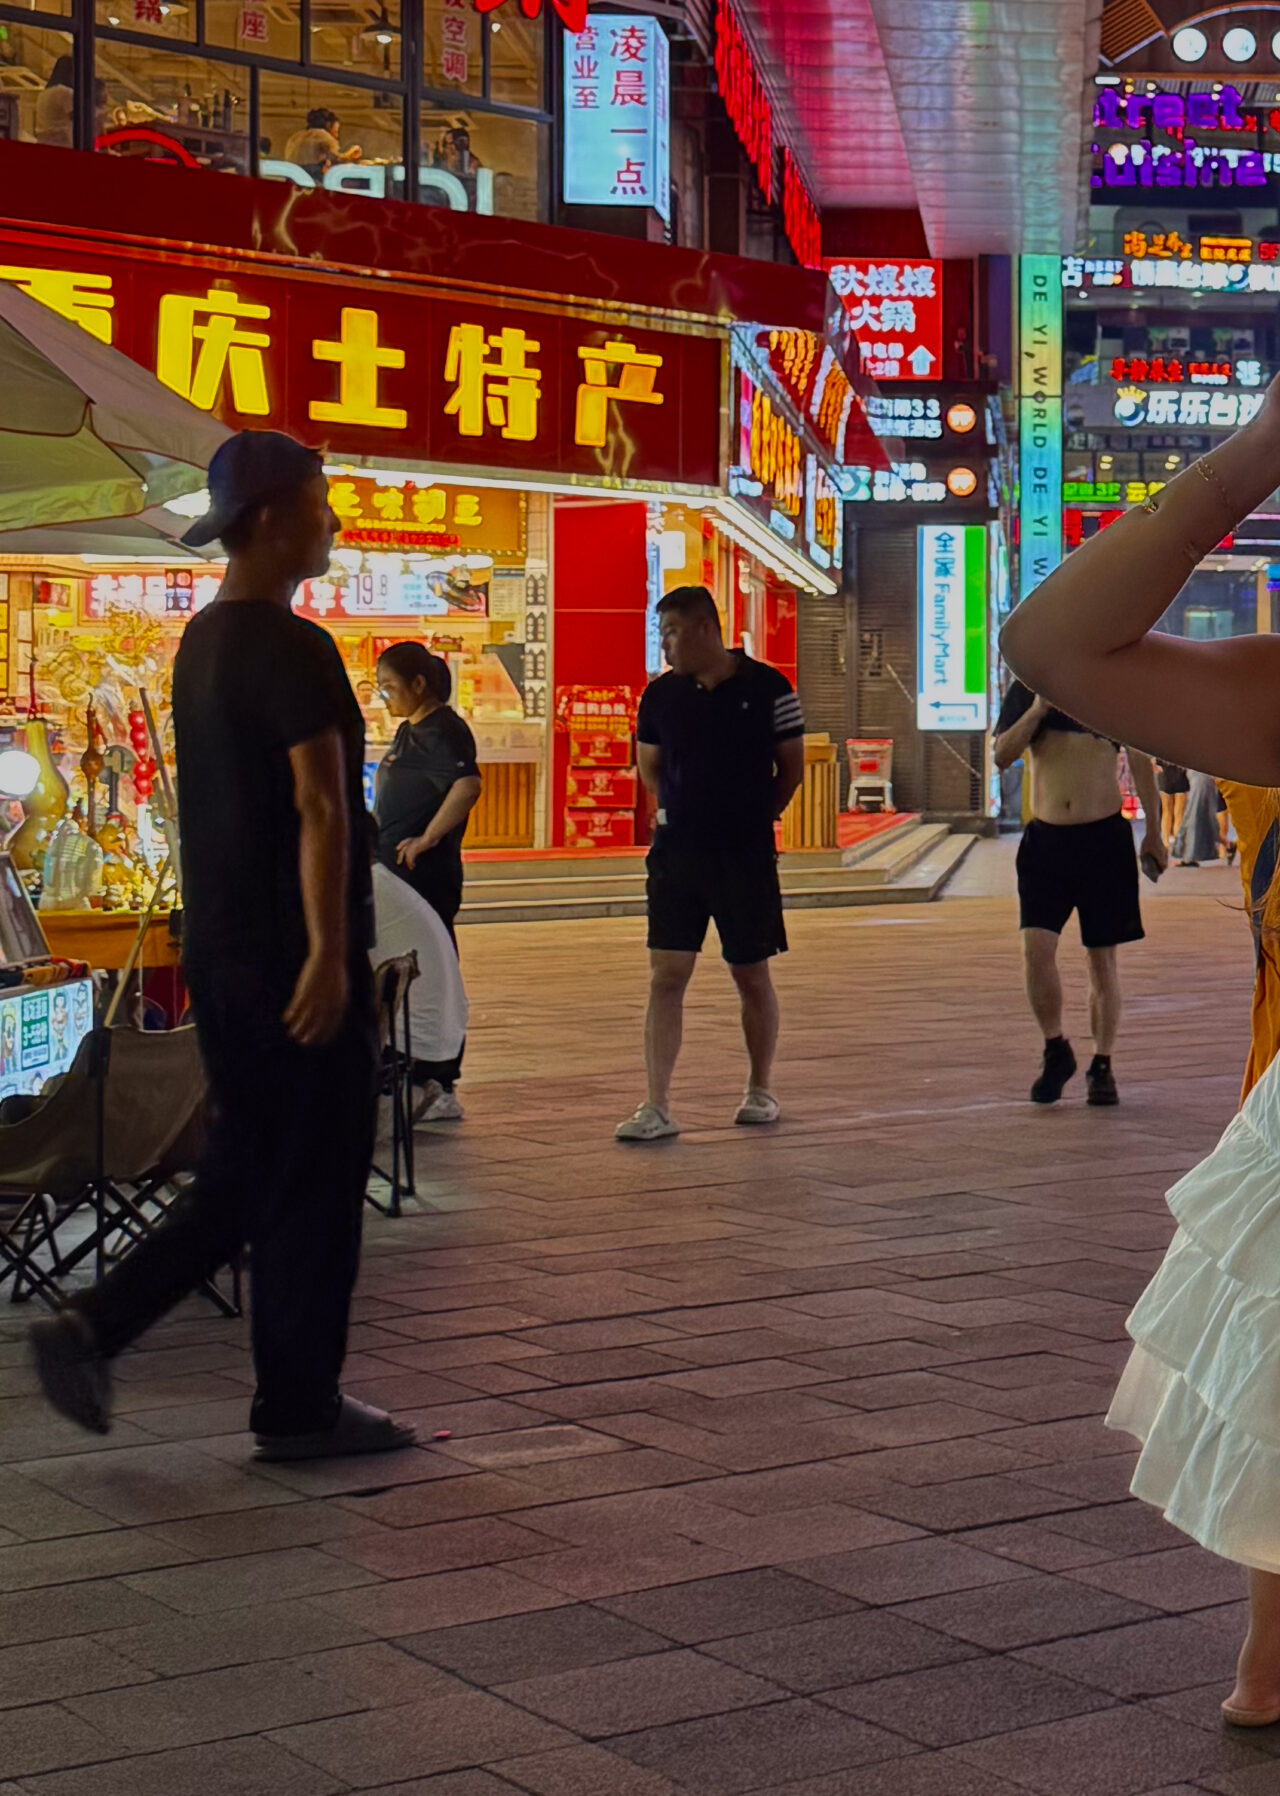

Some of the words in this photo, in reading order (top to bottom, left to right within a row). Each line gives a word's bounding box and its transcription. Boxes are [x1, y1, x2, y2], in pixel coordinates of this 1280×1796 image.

[572, 26, 599, 109] 营业至
[610, 25, 648, 195] 凌晨一点
[1093, 84, 1243, 129] treet
[1090, 138, 1267, 188] uisine
[1032, 274, 1048, 303] DE
[850, 299, 916, 333] 火锅
[1032, 366, 1048, 449] WORLD
[1032, 466, 1048, 495] DE
[934, 532, 956, 577] 全家
[930, 583, 950, 685] FamilyMart
